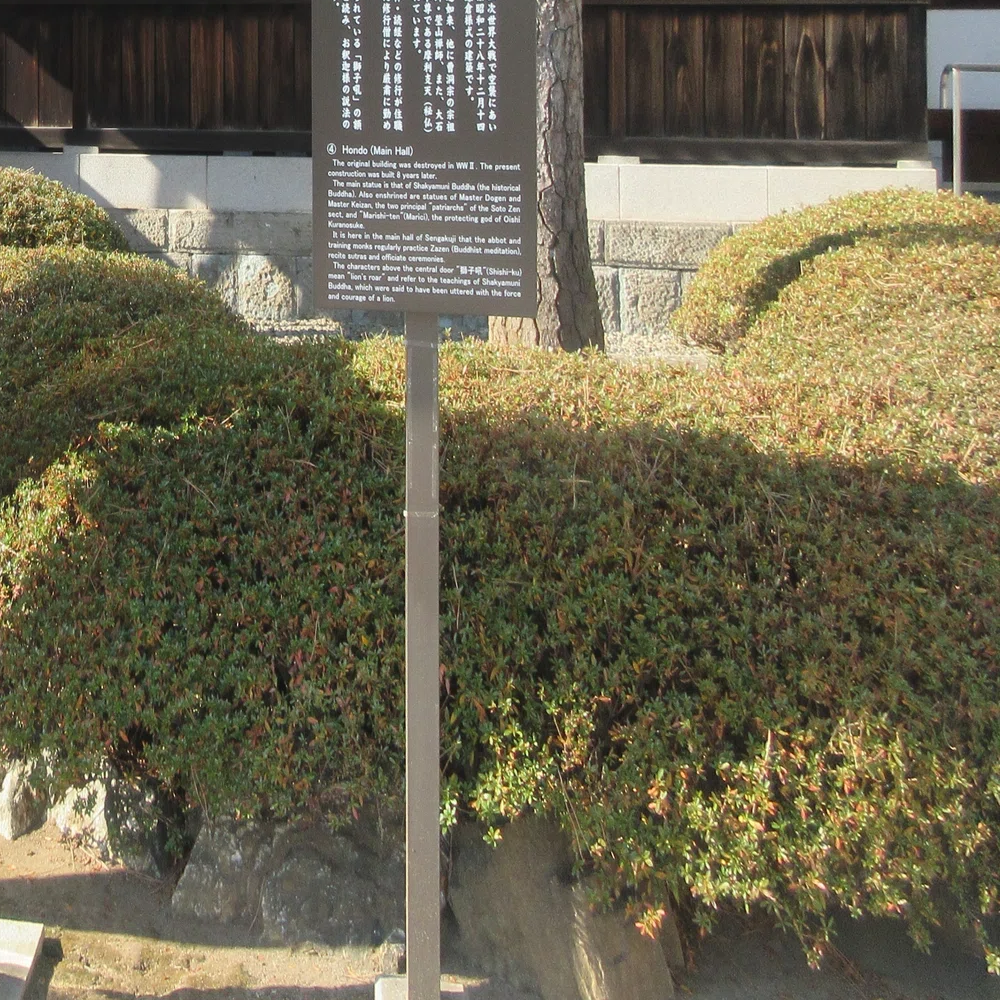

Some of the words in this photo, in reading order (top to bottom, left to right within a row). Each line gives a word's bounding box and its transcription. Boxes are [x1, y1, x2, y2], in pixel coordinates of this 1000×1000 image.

[342, 145, 368, 155] Hondo
[370, 145, 392, 155] (Main
[347, 159, 370, 168] original
[372, 160, 397, 169] building
[414, 161, 446, 170] destroyed
[448, 161, 454, 169] in
[480, 162, 492, 170] The
[495, 163, 520, 171] present
[328, 169, 366, 177] construction
[333, 179, 344, 187] The
[414, 182, 450, 191] Shakyamuni
[452, 182, 475, 190] Buddha
[477, 183, 490, 191] (the
[492, 183, 520, 192] historical
[375, 191, 407, 199] enshrined
[459, 193, 483, 201] Master
[485, 194, 506, 203] Dogen
[509, 194, 521, 202] and
[328, 200, 349, 208] Master
[401, 202, 426, 211] principal
[491, 204, 506, 212] Soto
[508, 205, 520, 213] Zen
[445, 214, 478, 223] protecting
[481, 215, 492, 224] god
[494, 215, 501, 223] of
[504, 215, 520, 223] Oishi
[402, 233, 414, 241] hall
[425, 234, 456, 243] Sengakuji
[458, 235, 472, 243] that
[488, 236, 507, 244] abbot
[328, 241, 351, 250] training
[353, 242, 372, 250] monks
[374, 243, 401, 252] regularly
[403, 244, 428, 252] practice
[430, 244, 449, 252] Zazen
[451, 245, 482, 254] (Buddhist
[328, 251, 346, 259] recite
[381, 253, 406, 261] officiate
[333, 261, 345, 269] The
[347, 262, 380, 271] characters
[415, 265, 437, 273] central
[387, 274, 399, 282] and
[440, 276, 471, 286] teachings
[482, 278, 520, 288] Shakyamuni
[328, 292, 339, 300] and
[355, 283, 373, 291] which
[392, 284, 404, 292] said
[432, 286, 448, 294] been
[450, 287, 474, 295] uttered
[476, 288, 489, 296] with
[504, 289, 521, 297] force
